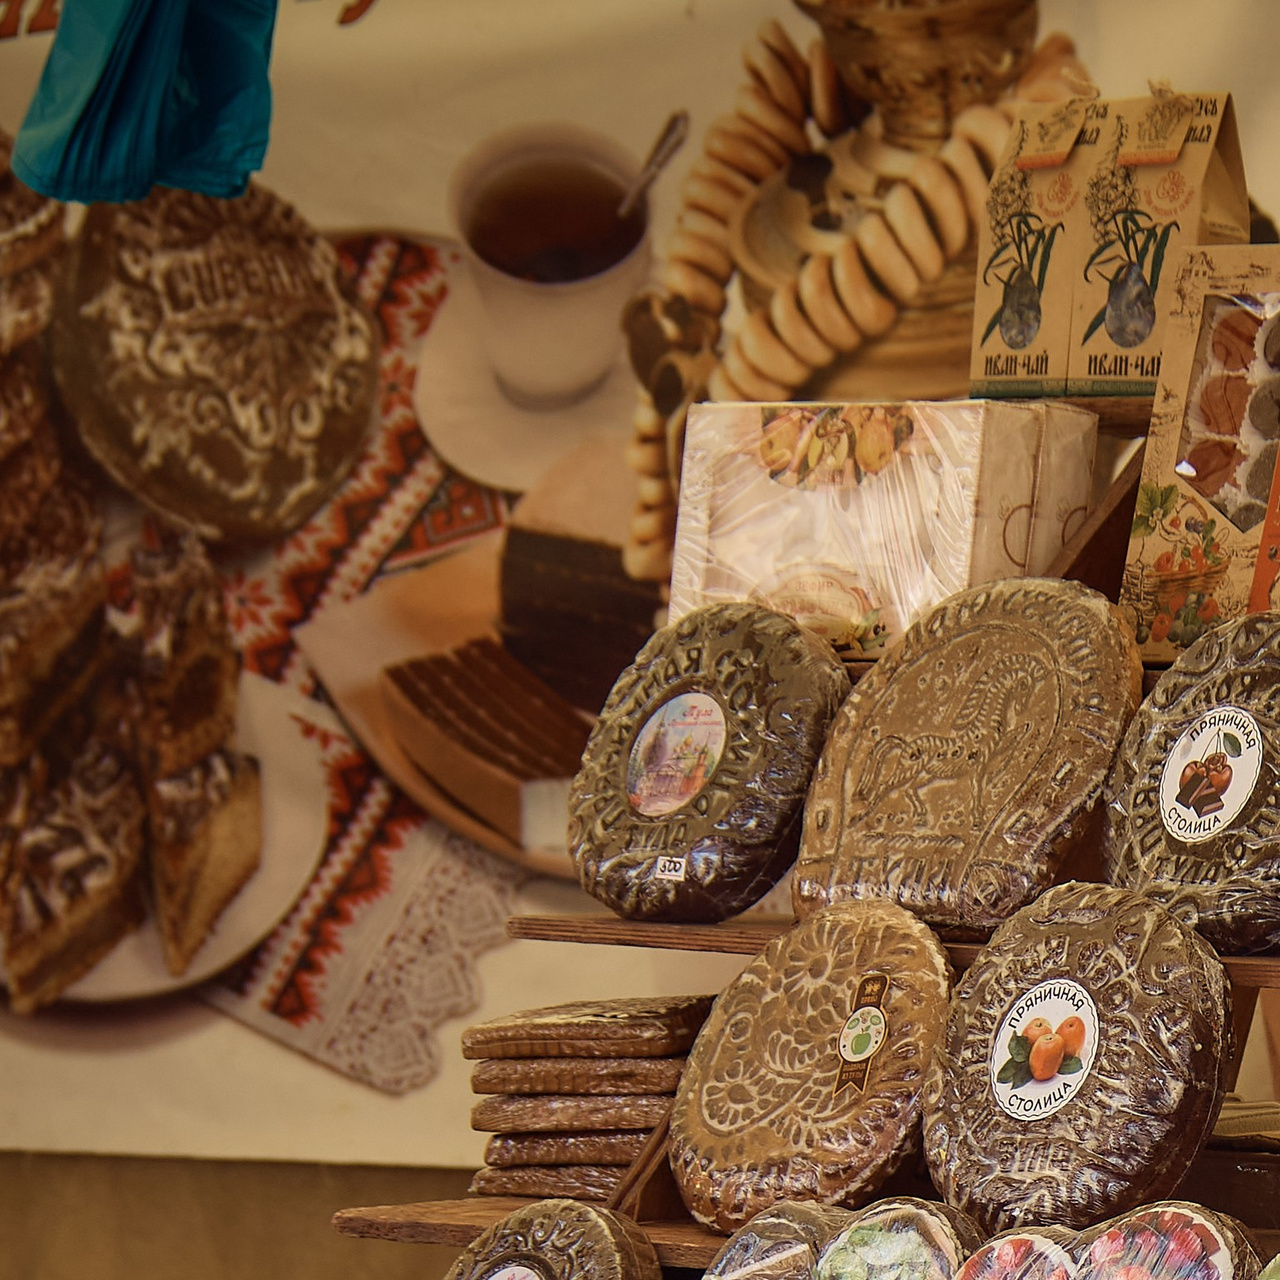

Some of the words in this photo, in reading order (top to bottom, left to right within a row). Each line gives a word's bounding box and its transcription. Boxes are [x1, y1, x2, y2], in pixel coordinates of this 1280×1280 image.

[1190, 712, 1256, 750] ПРЯНИЧНАЯ
[1167, 807, 1222, 834] СТОЛИЦА
[1008, 986, 1085, 1029] ПРЯНИЧНАЯ
[1008, 1081, 1072, 1112] СТОЛИЦА
